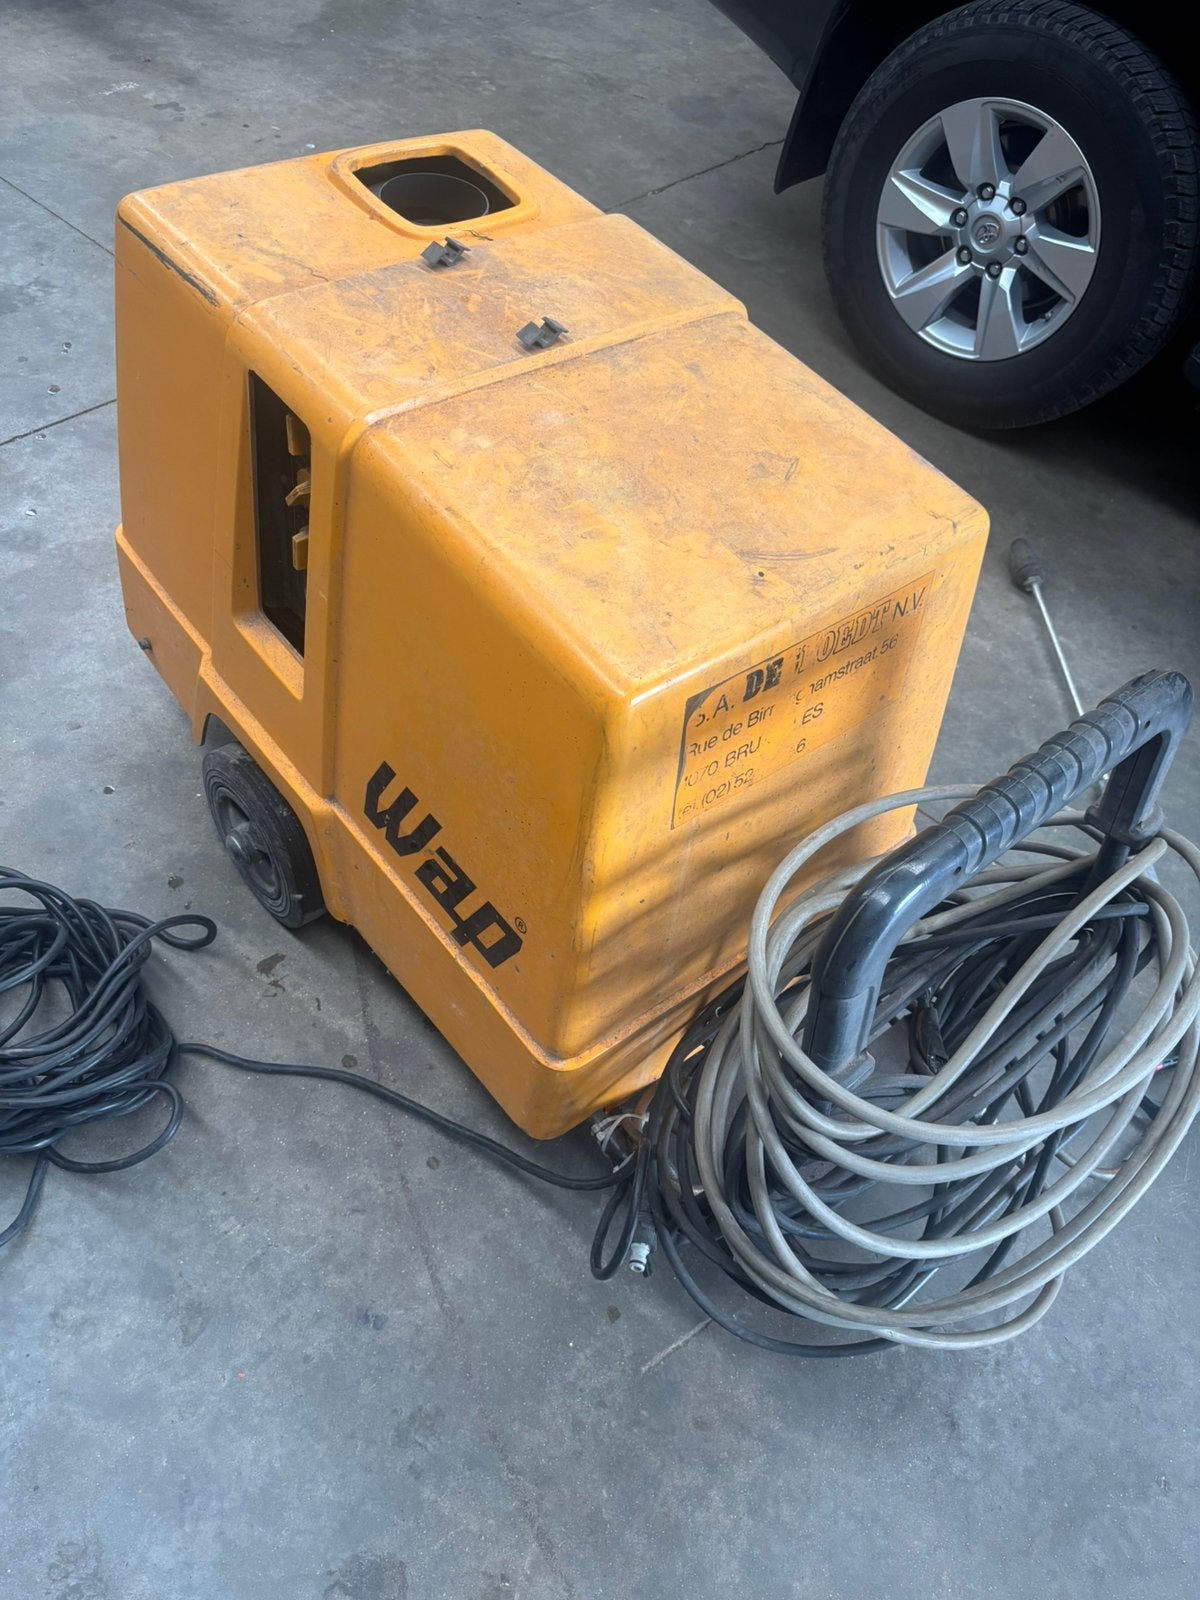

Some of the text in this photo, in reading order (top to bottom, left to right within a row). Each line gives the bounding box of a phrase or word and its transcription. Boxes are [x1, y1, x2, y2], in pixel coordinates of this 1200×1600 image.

[742, 657, 784, 703] DE
[892, 586, 926, 623] N.V.
[722, 722, 743, 742] de
